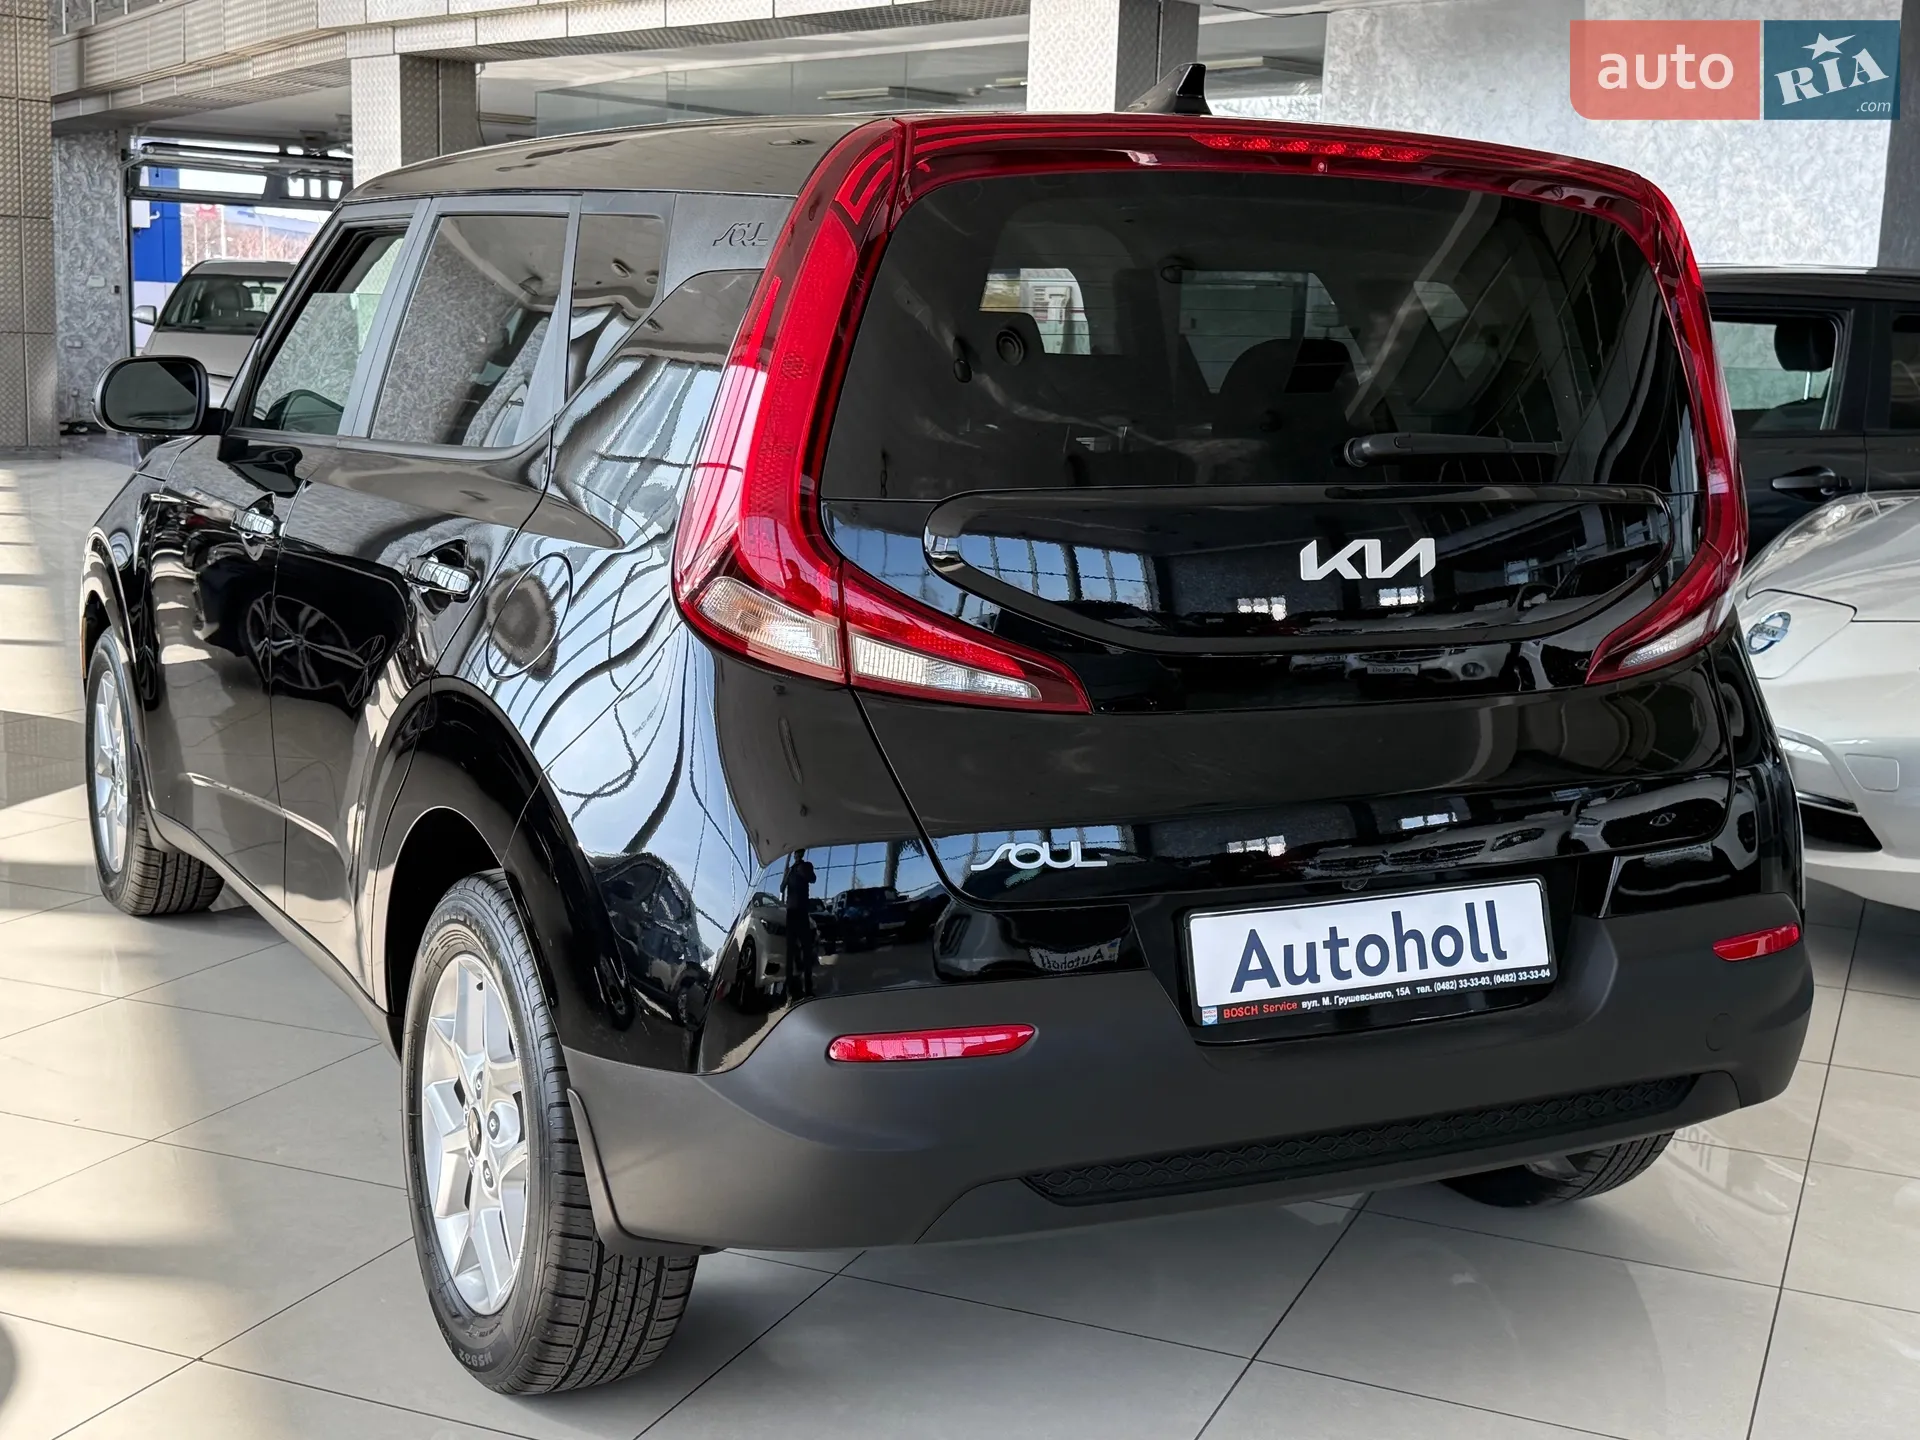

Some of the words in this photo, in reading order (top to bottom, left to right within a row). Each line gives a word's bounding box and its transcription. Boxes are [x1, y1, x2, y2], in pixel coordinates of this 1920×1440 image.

[1300, 538, 1435, 581] KIA
[970, 841, 1108, 871] SOUL
[1229, 899, 1508, 994] Autoholl
[1223, 1004, 1259, 1019] BOSCH
[1263, 1000, 1298, 1013] Service
[1301, 999, 1320, 1010] вул.
[1334, 989, 1394, 1006] Грушевського,
[1416, 985, 1432, 994] тел.
[1434, 980, 1457, 993] (0482)
[1493, 972, 1517, 985] (0482)
